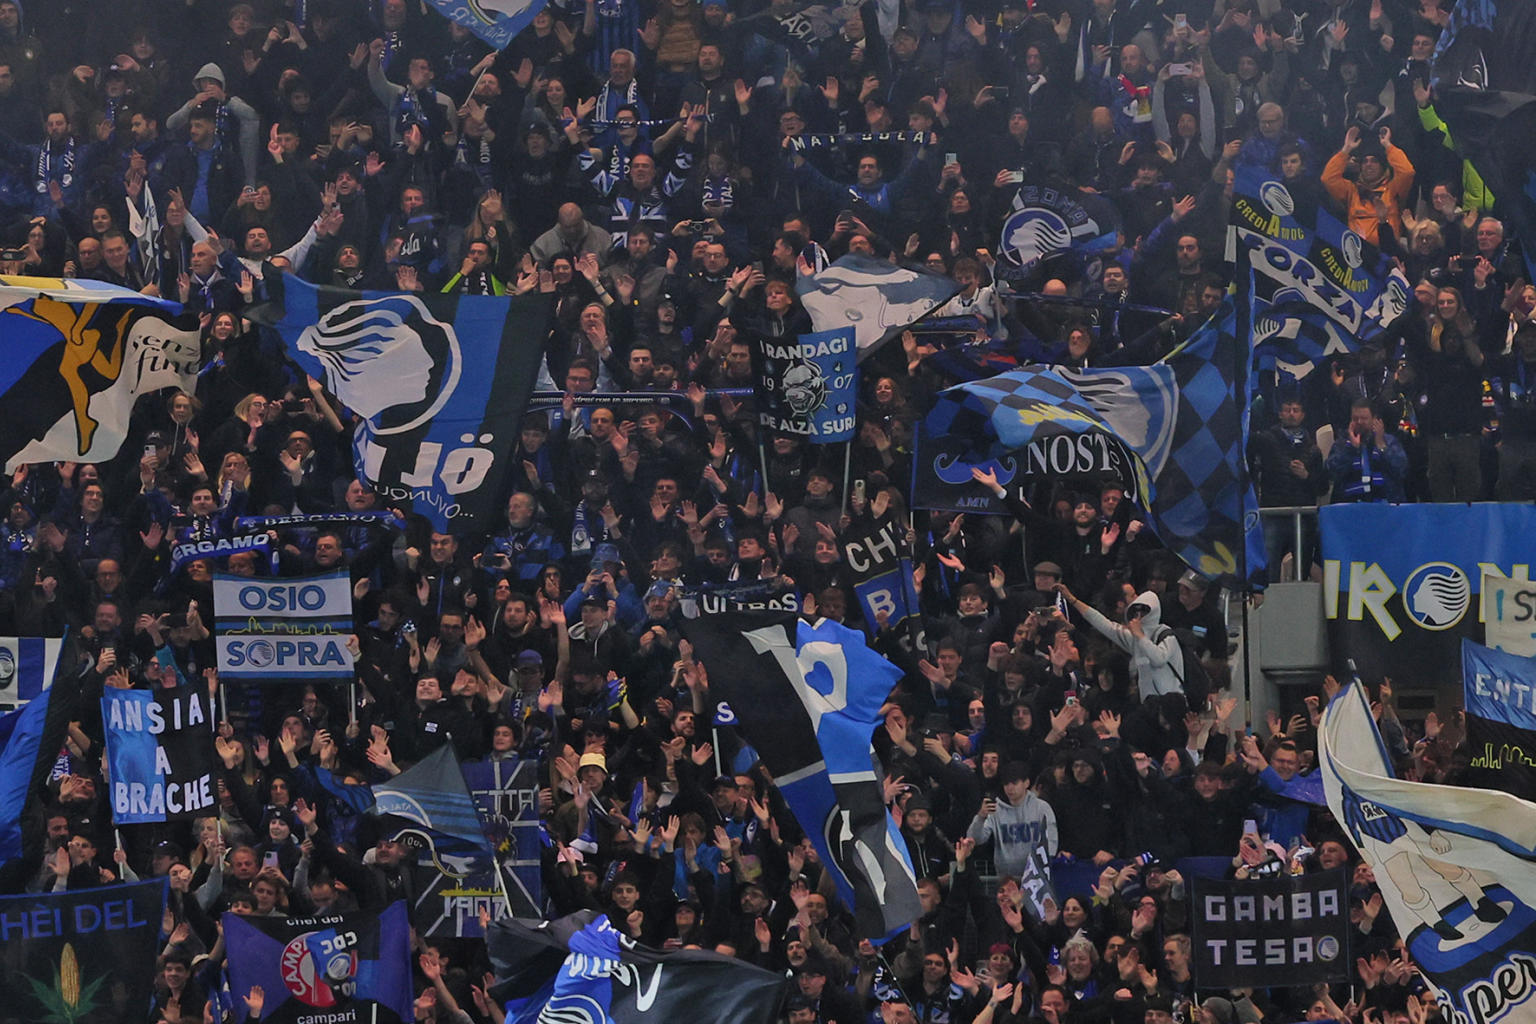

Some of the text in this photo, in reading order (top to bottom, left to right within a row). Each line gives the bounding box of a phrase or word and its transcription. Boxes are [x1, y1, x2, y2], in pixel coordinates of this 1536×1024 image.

[766, 337, 849, 360] RANDAGI
[832, 373, 855, 391] 07
[238, 584, 327, 611] OSIO
[109, 692, 205, 735] ANSIA
[154, 745, 173, 776] A
[115, 773, 215, 815] BRACHE
[73, 898, 148, 934] DEL
[1204, 888, 1340, 923] GAMBA
